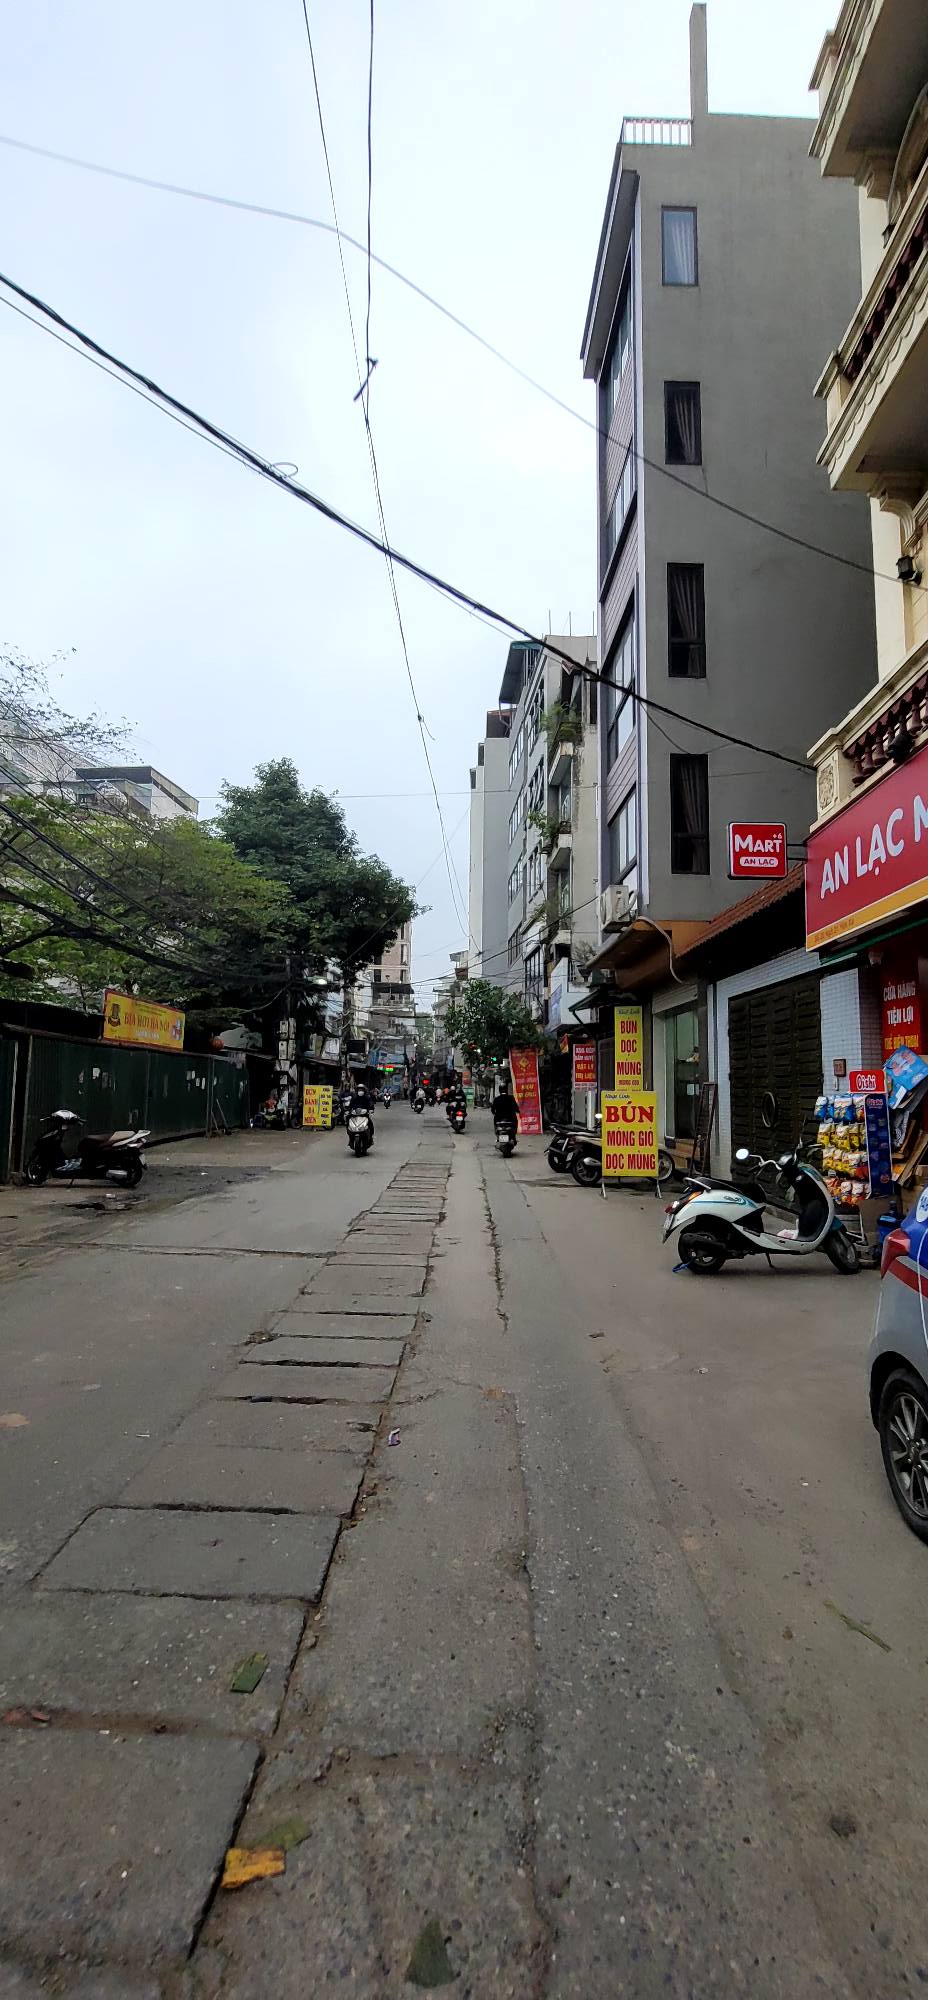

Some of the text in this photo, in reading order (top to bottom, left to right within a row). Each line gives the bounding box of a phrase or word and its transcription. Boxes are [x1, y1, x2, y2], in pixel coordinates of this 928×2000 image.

[734, 834, 782, 853] MART
[820, 845, 849, 900] AN
[855, 808, 905, 877] LẠC
[897, 981, 916, 999] HÀNG
[887, 1005, 914, 1026] TIỆN LỢI
[620, 1017, 638, 1034] BÚN
[620, 1040, 638, 1057] DỌC
[616, 1058, 642, 1076] MÙNG
[856, 1074, 876, 1091] Oishi
[605, 1101, 655, 1123] BÚN
[606, 1127, 635, 1147] MÓNG
[605, 1150, 656, 1173] DỌC MÙNG
